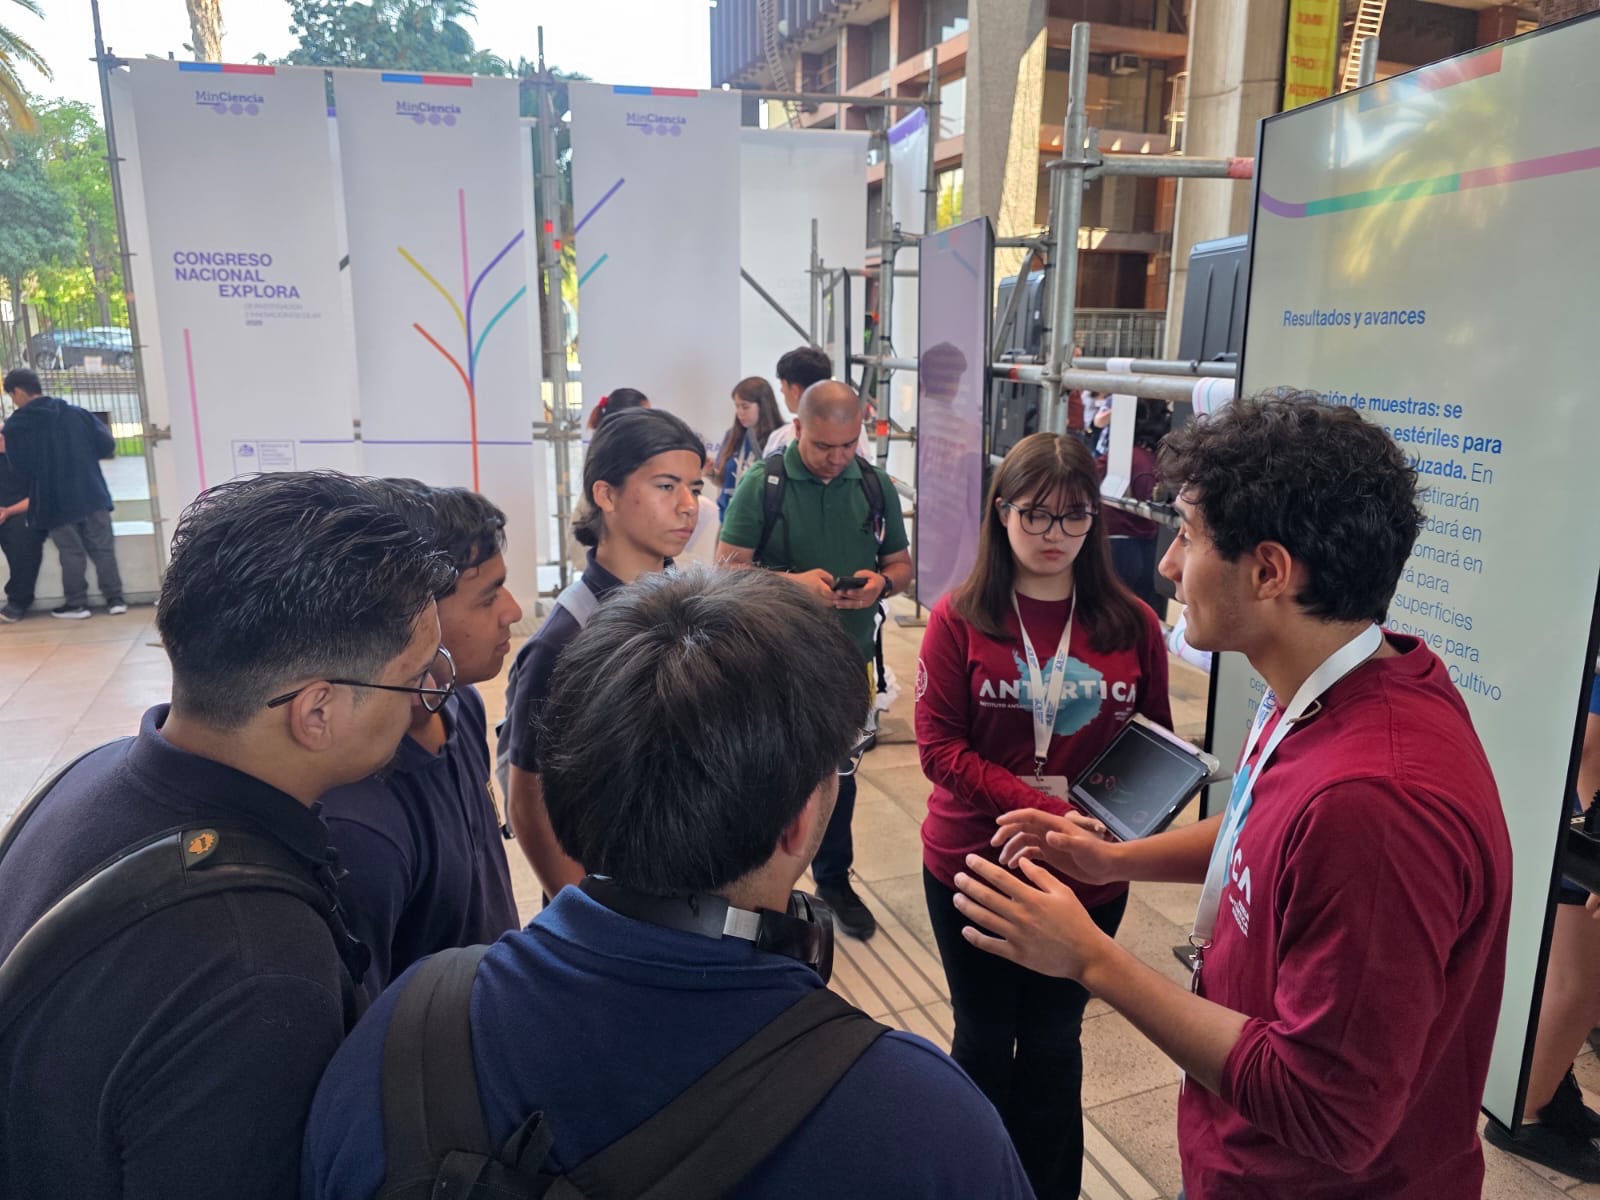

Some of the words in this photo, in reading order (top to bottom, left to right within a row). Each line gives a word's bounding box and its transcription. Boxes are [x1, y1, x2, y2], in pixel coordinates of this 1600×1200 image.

[196, 91, 264, 103] MinCiencia
[396, 101, 461, 113] MinCiencia
[626, 112, 686, 124] MinCiencia
[173, 251, 272, 267] CONGRESO
[175, 268, 265, 282] NACIONAL
[219, 284, 300, 298] EXPLORA
[1283, 309, 1350, 326] Resultados
[1353, 311, 1361, 329] y
[1364, 309, 1426, 325] avances
[1350, 393, 1366, 410] de
[1368, 397, 1440, 417] muestras:
[1444, 403, 1463, 419] se
[1393, 425, 1460, 449] estériles
[1462, 435, 1503, 454] para
[1471, 462, 1493, 485] En
[1462, 526, 1482, 543] en
[1411, 543, 1460, 567] omará
[1463, 556, 1483, 575] en
[1416, 572, 1449, 594] para
[1394, 593, 1474, 631] superficies
[1445, 638, 1480, 663] para
[1447, 664, 1502, 701] Cultivo
